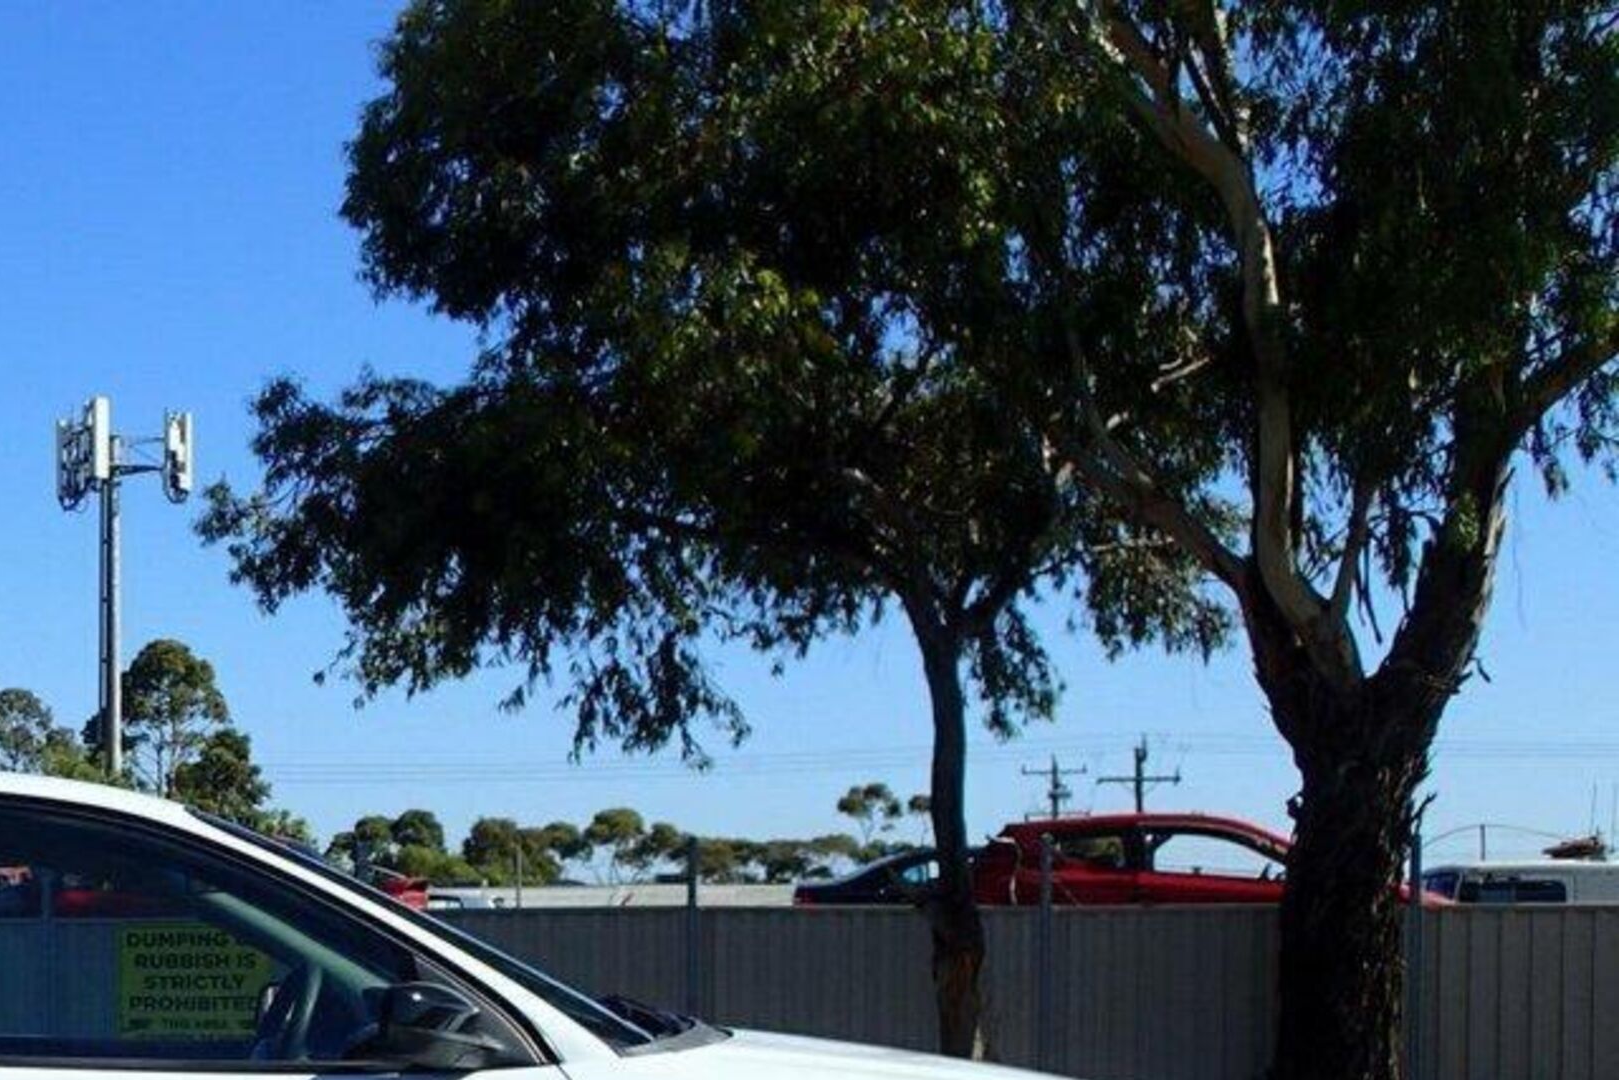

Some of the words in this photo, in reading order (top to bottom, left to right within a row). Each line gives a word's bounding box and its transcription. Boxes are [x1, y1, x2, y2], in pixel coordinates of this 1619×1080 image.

[126, 931, 230, 947] DUMPING
[134, 952, 229, 969] RUBBISH
[237, 952, 257, 969] IS
[142, 974, 245, 990] STRICTLY
